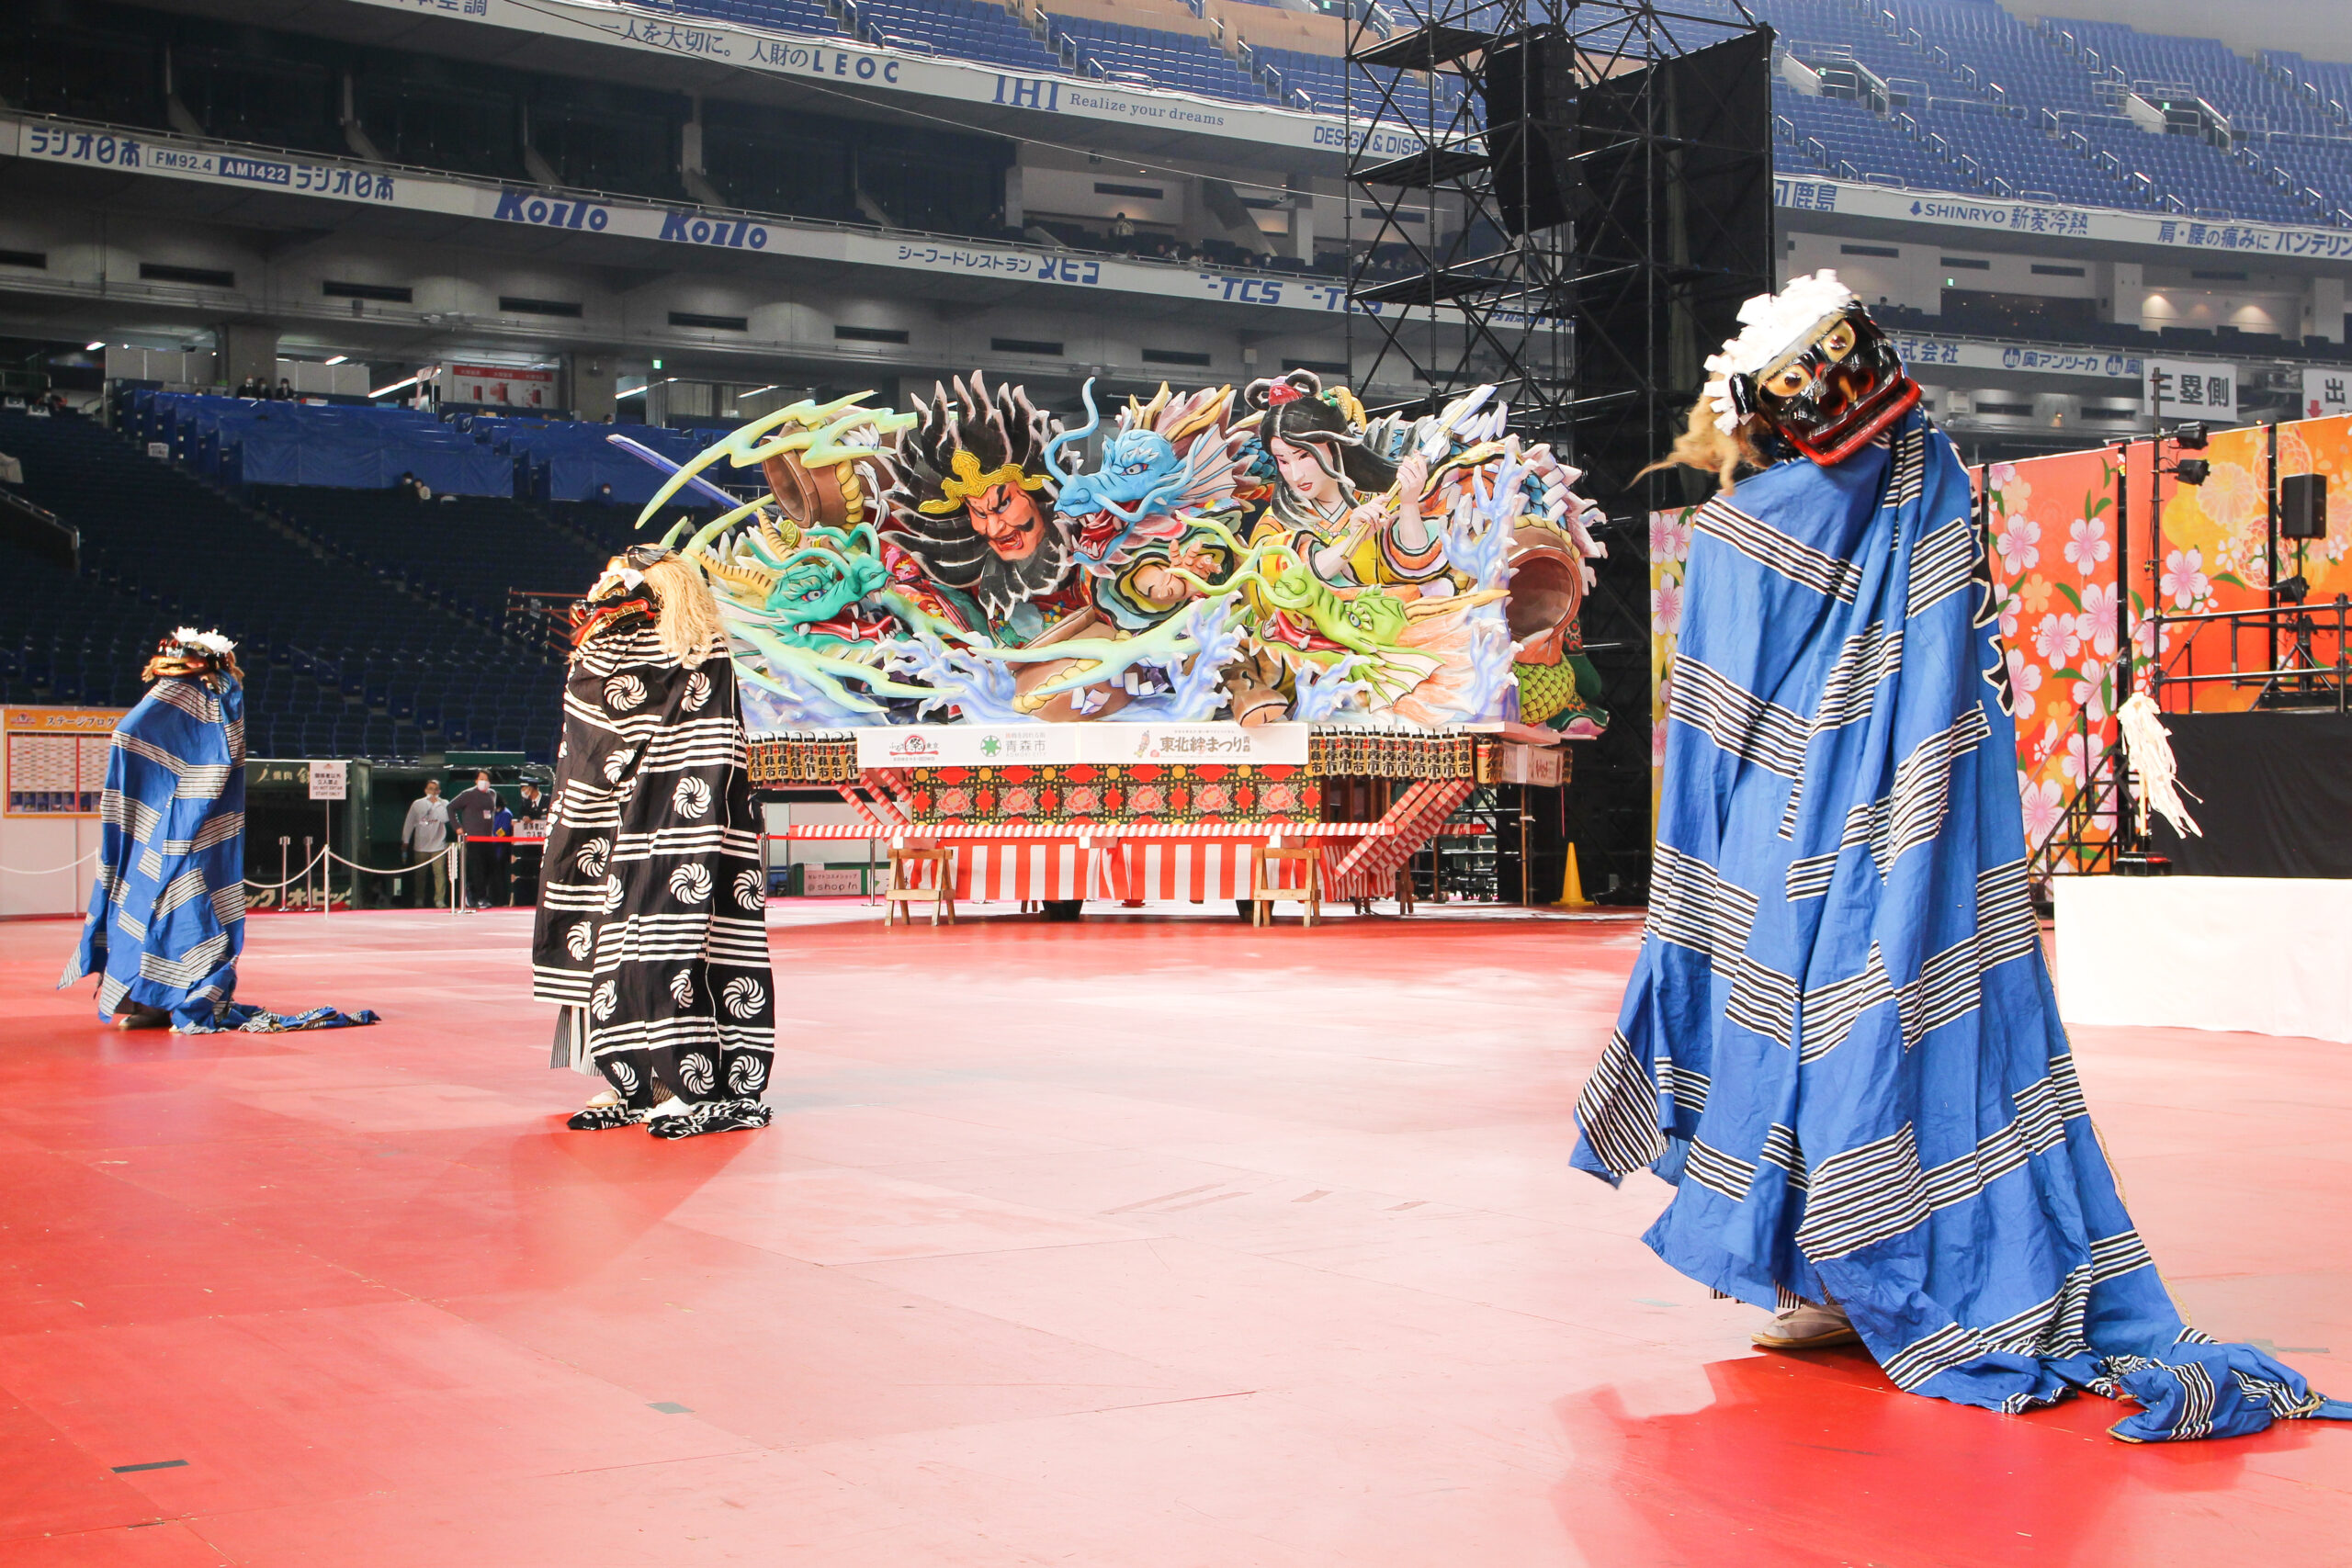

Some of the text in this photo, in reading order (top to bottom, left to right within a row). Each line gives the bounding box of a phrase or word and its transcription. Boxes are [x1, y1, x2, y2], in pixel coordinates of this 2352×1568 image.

[992, 74, 1225, 127] IHI Realize your dreams
[30, 127, 141, 167] ラジオ日本
[1313, 126, 1369, 150] DESGN
[1373, 134, 1383, 152] &
[155, 151, 287, 182] FM92.4 AM1422
[296, 164, 394, 201] ラジオ日本
[1924, 203, 2006, 223] SHINRYO
[898, 245, 1101, 285] シーフードレストラン メヒコ
[1901, 339, 1959, 364] 式会社
[2150, 372, 2230, 408] 三塁側
[1005, 739, 1046, 752] 青森市
[1159, 736, 1242, 753] 東北絆まつり
